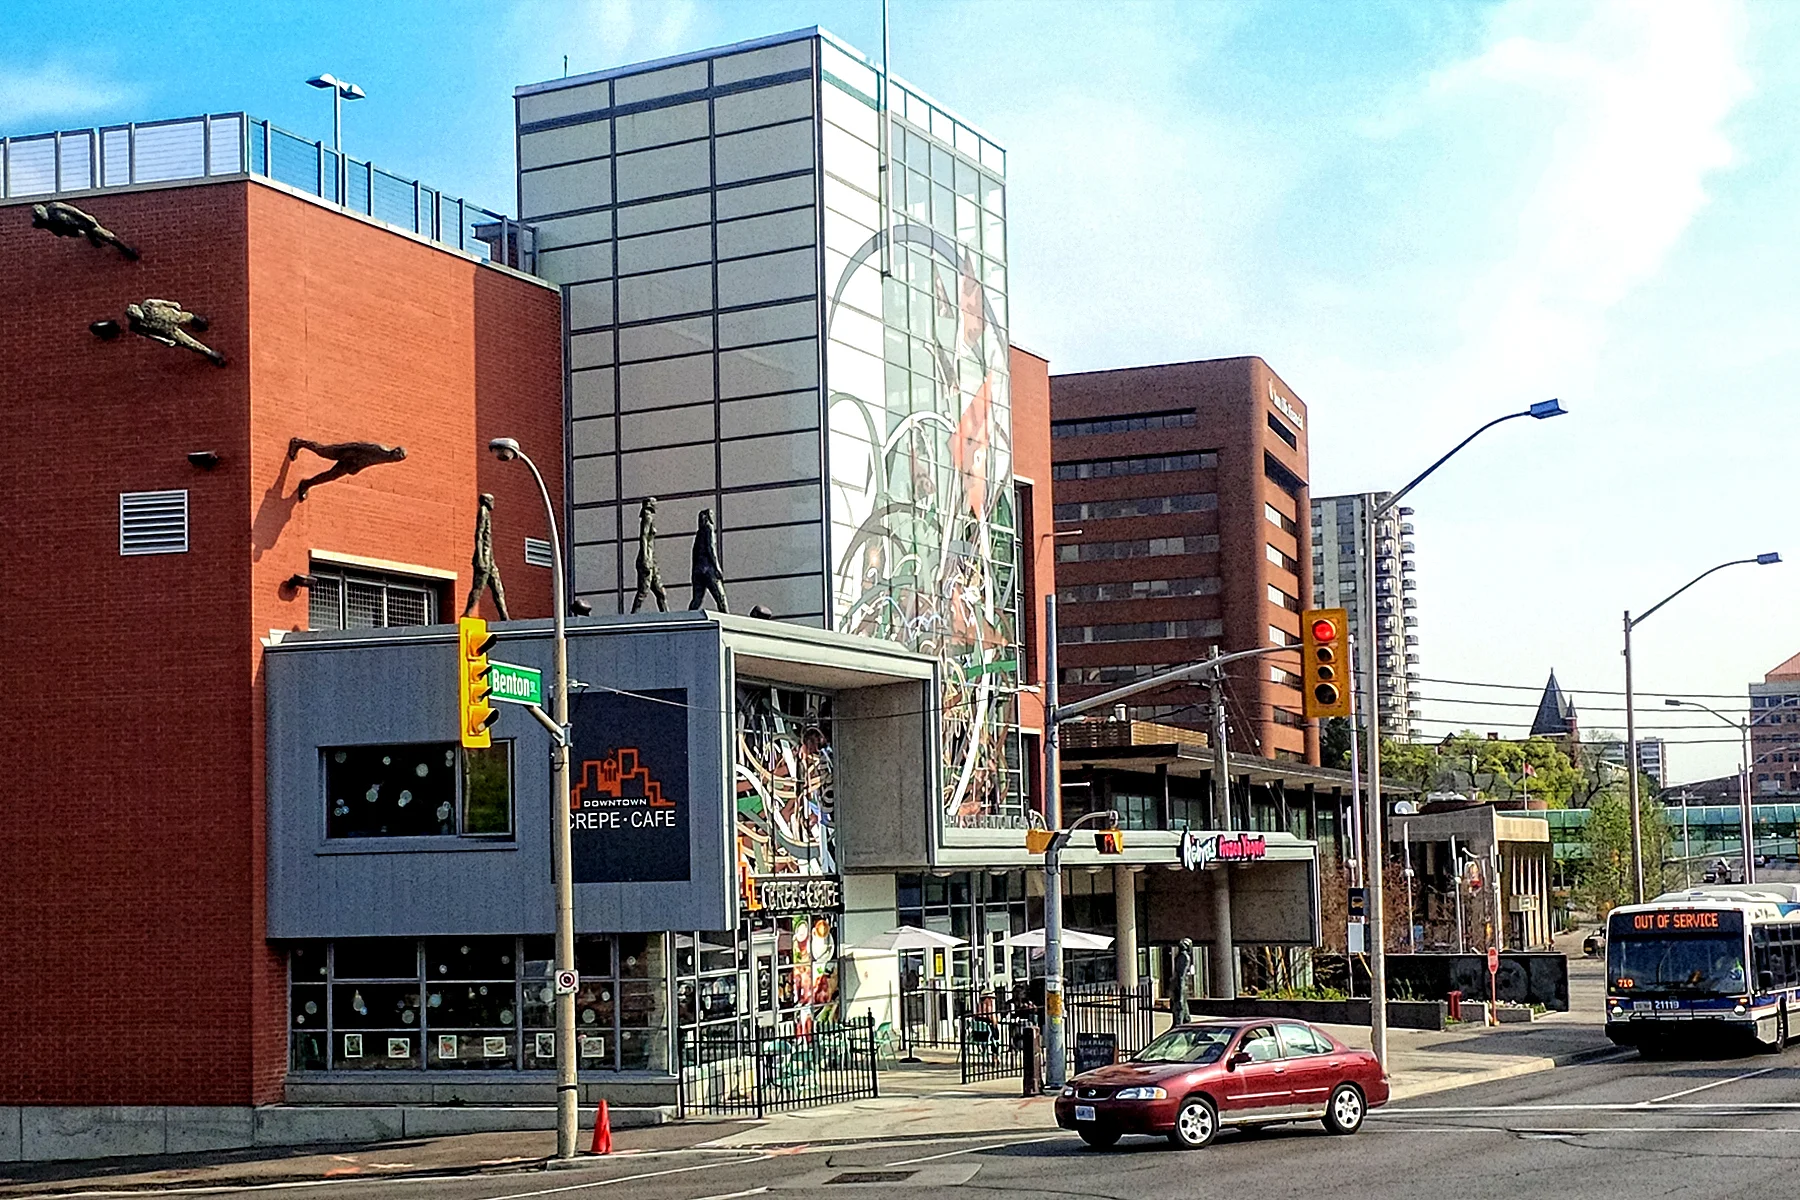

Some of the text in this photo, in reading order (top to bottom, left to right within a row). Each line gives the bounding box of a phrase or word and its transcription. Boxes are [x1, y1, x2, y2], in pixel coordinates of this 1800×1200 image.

[492, 668, 530, 697] Benton
[584, 799, 647, 808] DOWNTOWN
[569, 810, 676, 829] CREPE CAFE
[1634, 912, 1719, 929] OUT OF SERVICE
